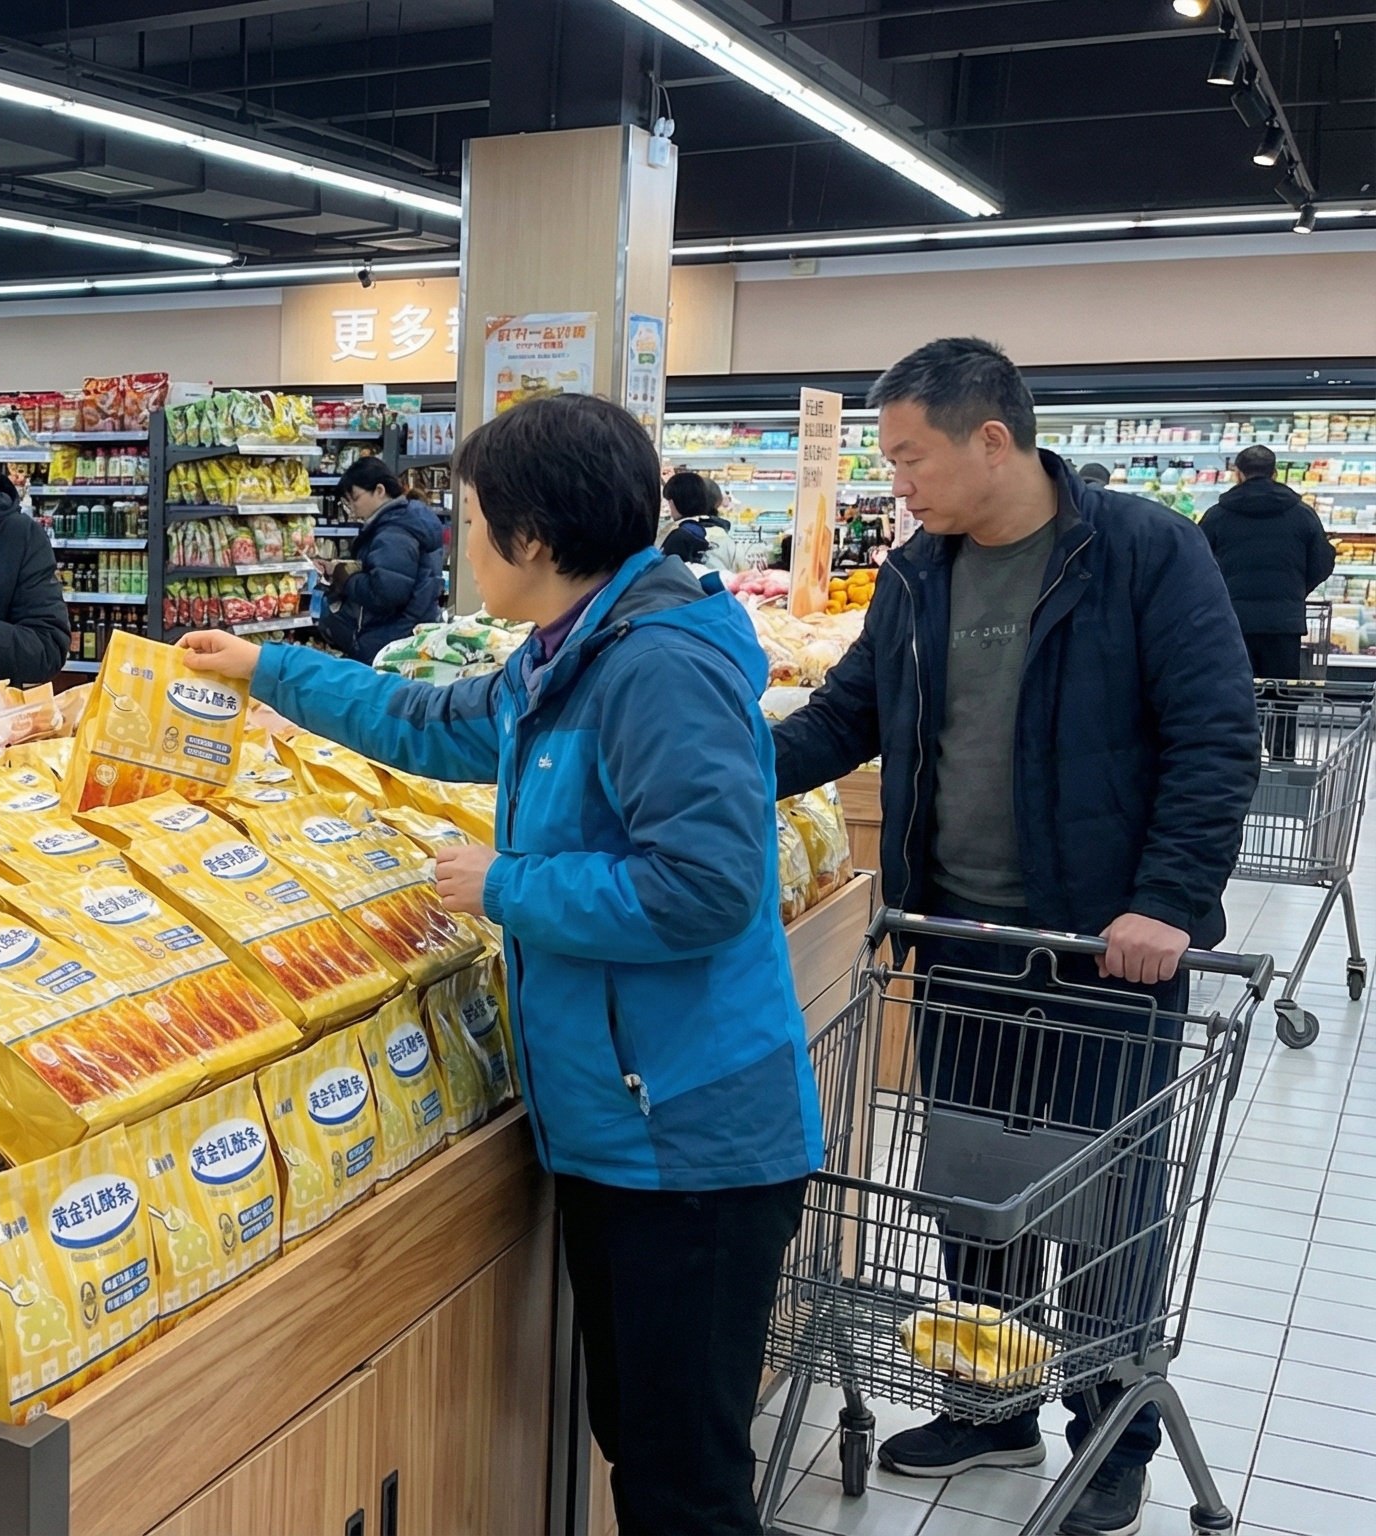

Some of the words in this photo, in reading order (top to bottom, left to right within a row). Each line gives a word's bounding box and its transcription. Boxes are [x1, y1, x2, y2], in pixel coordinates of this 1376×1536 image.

[330, 303, 458, 362] 更多
[52, 1182, 134, 1232] 黄金乳酪条
